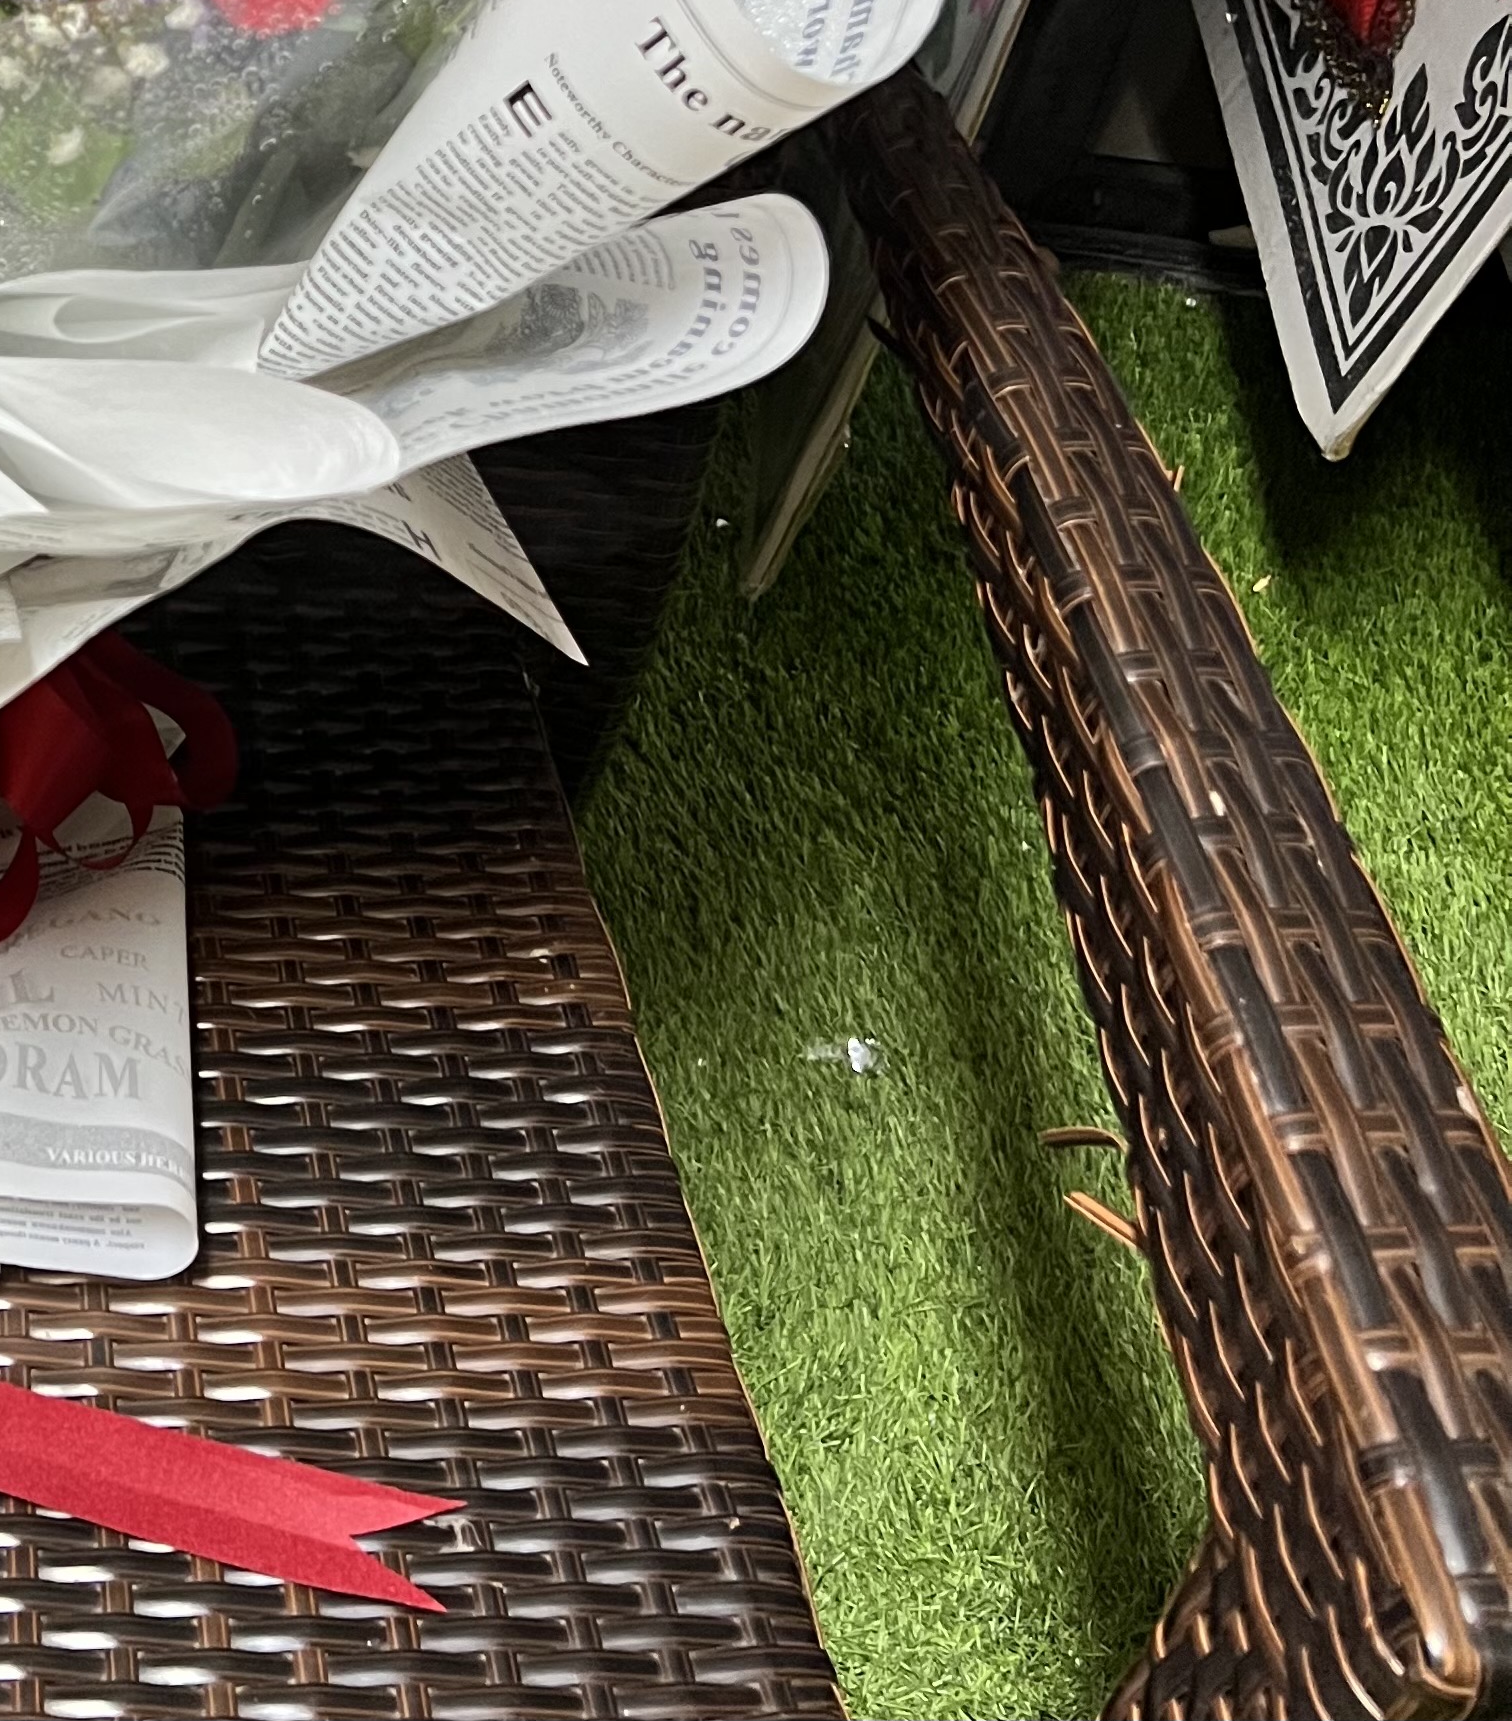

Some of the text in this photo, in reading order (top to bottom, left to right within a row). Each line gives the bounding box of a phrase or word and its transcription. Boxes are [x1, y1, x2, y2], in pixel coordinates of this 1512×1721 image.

[639, 17, 708, 110] The
[548, 52, 612, 140] Noteworthy
[60, 945, 150, 973] CAPER
[45, 1145, 135, 1167] VARIOUS
